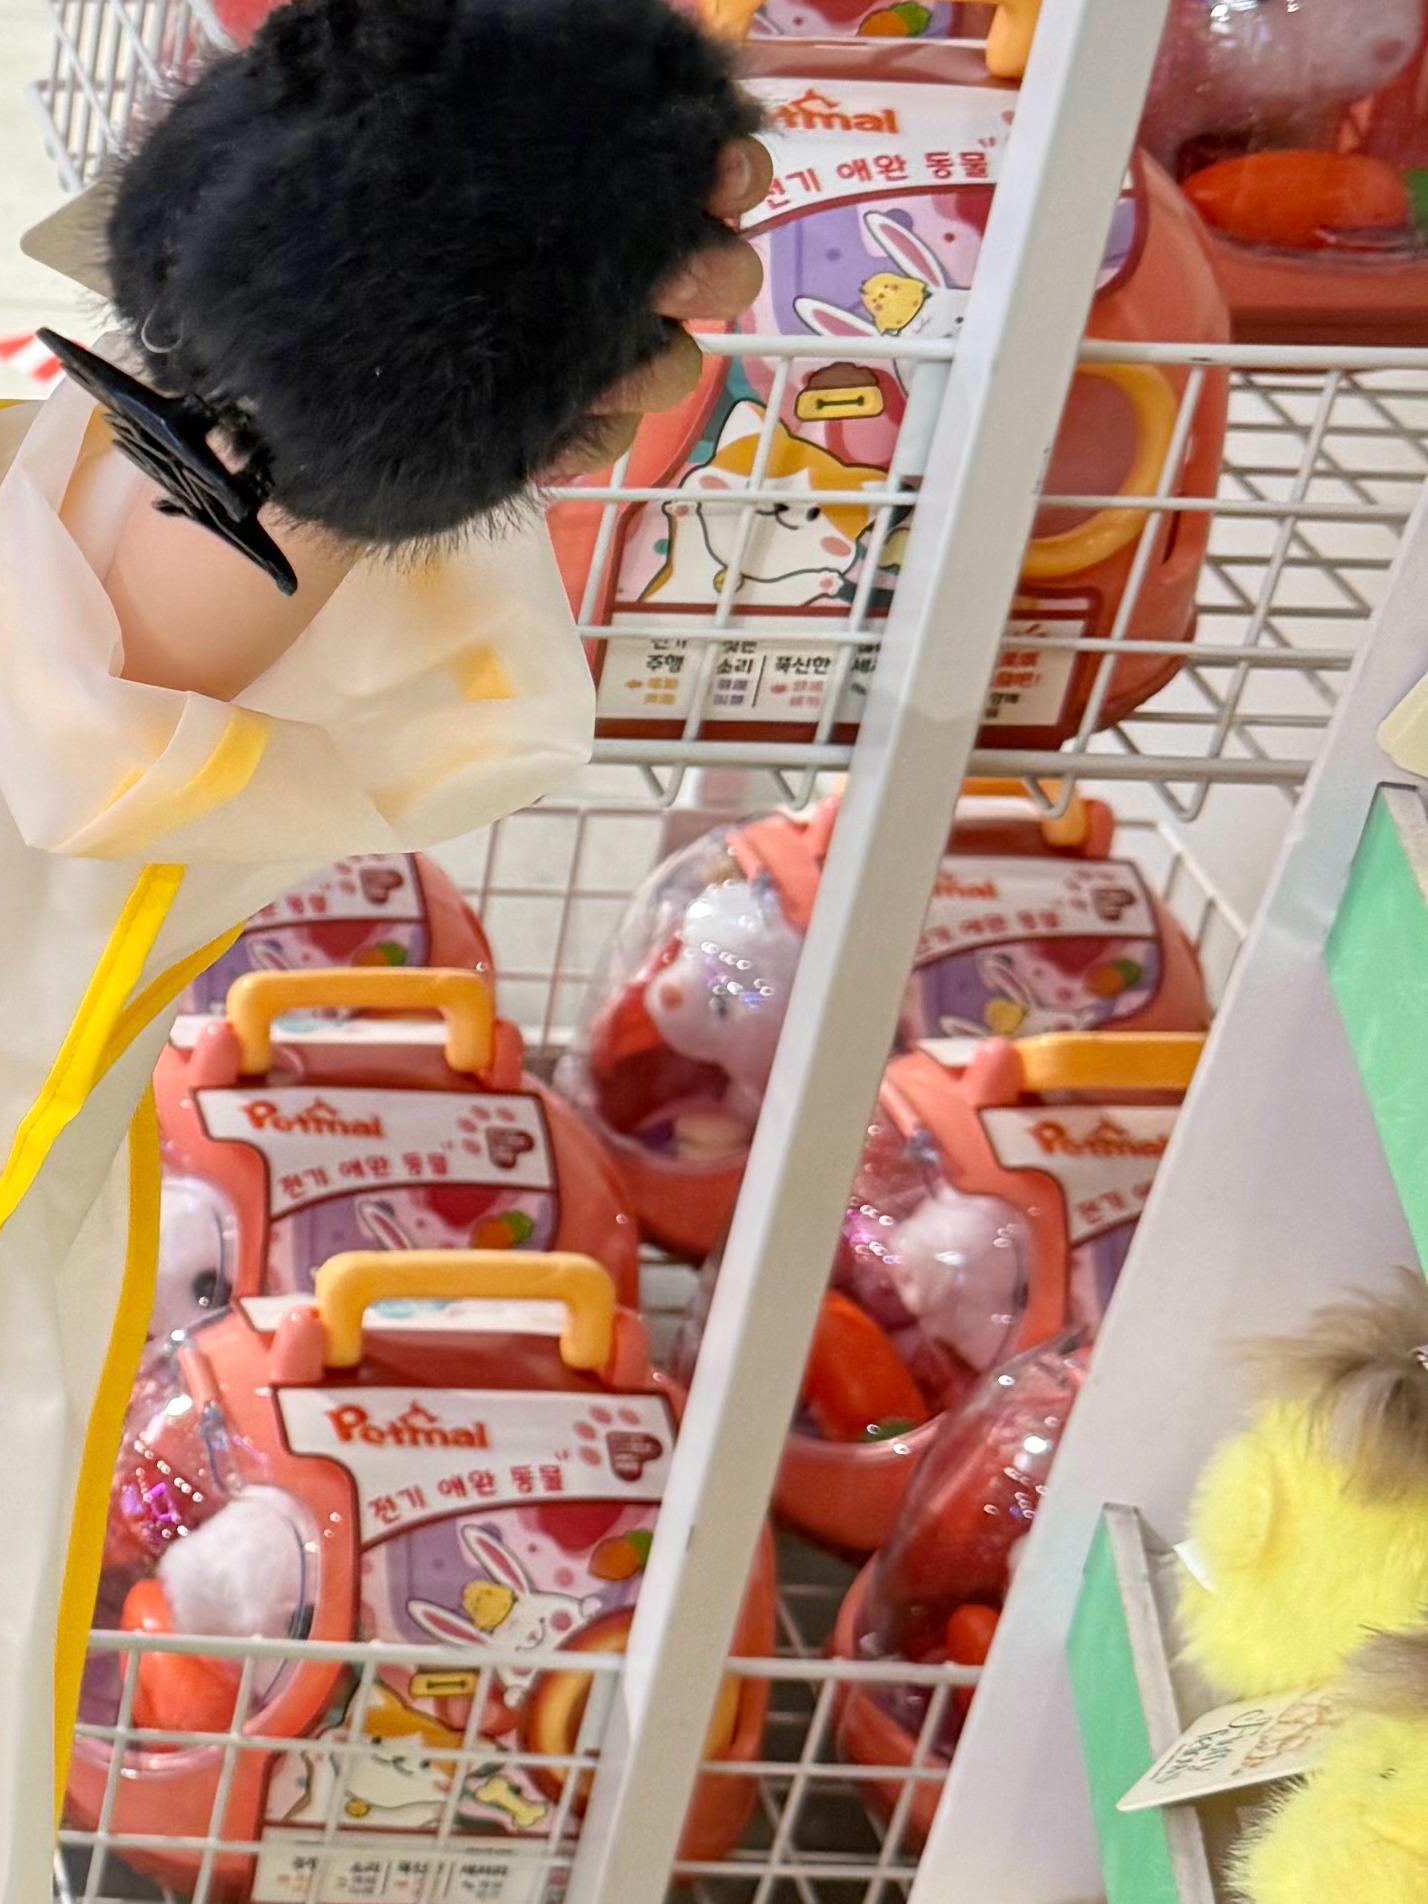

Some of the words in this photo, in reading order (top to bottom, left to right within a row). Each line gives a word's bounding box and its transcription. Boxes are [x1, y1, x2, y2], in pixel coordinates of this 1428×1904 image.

[775, 89, 900, 134] tmal
[836, 154, 909, 182] 애완
[924, 150, 989, 179] 동물
[646, 654, 685, 674] 주행
[716, 658, 754, 675] 소리
[368, 1483, 428, 1526] 전기
[436, 1469, 498, 1499] 애완
[509, 1464, 563, 1493] 동물
